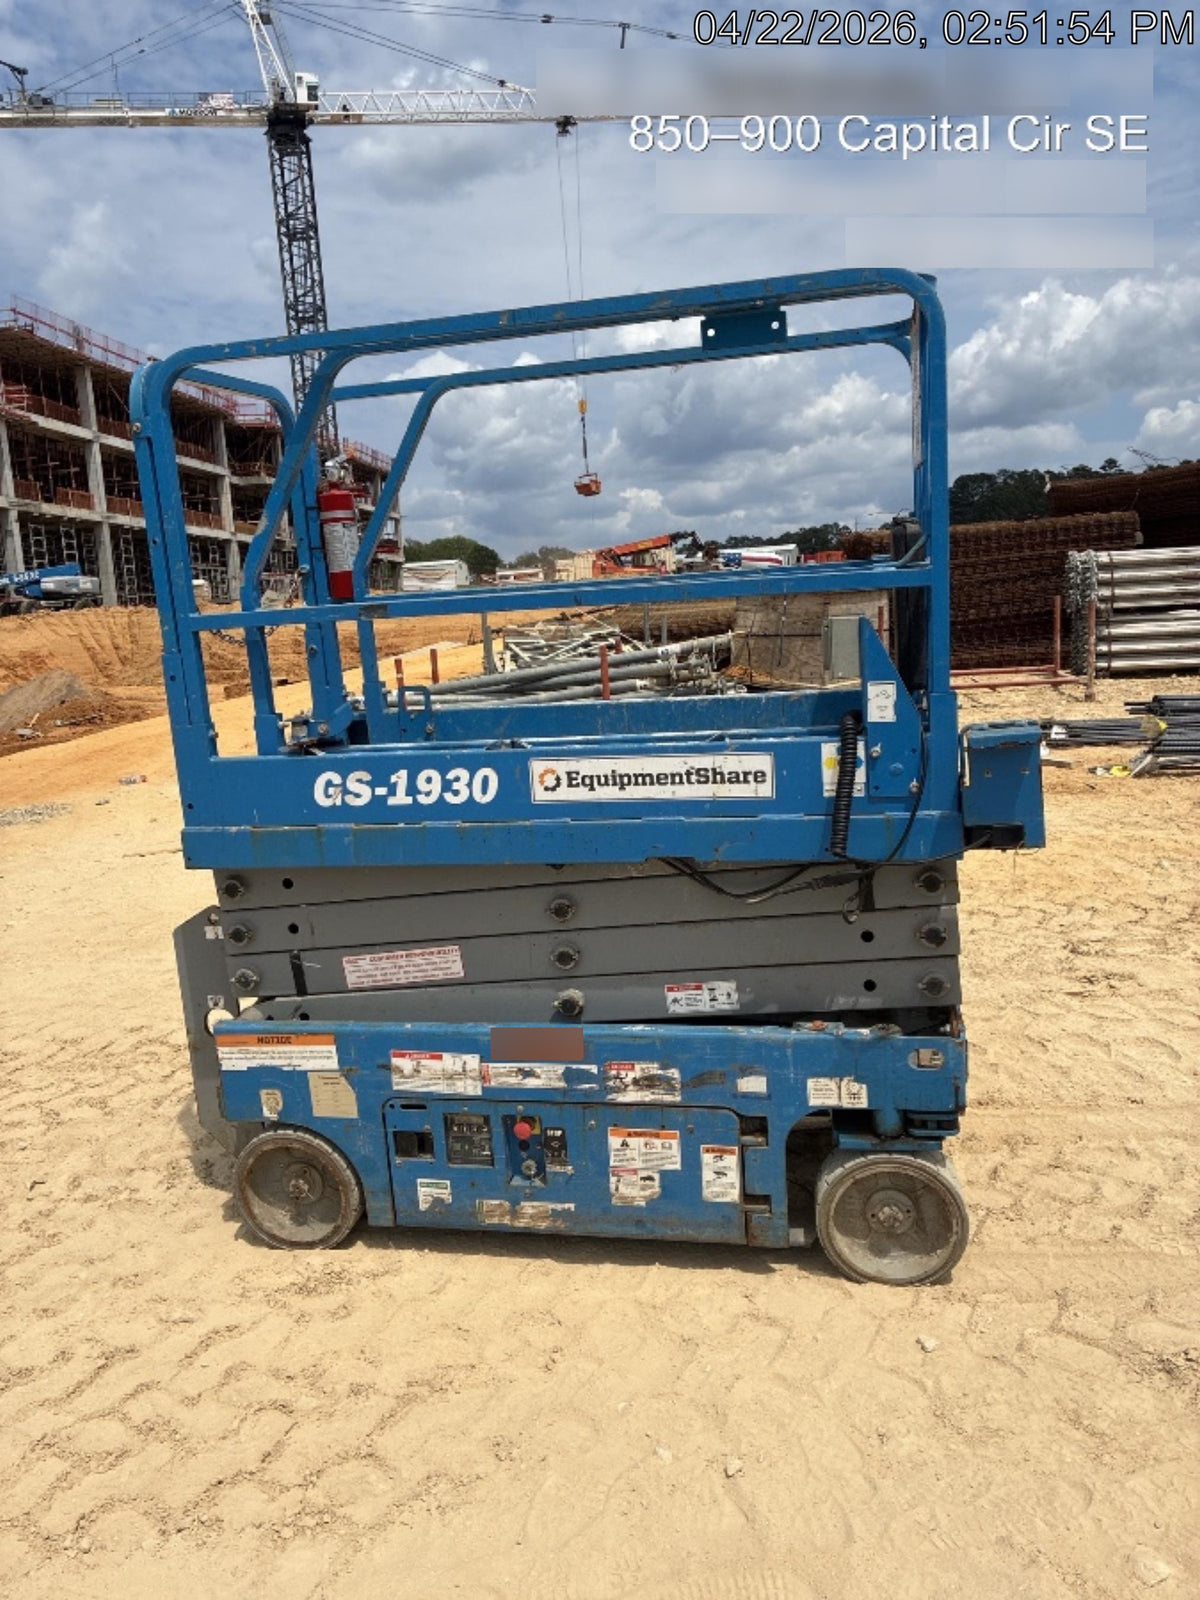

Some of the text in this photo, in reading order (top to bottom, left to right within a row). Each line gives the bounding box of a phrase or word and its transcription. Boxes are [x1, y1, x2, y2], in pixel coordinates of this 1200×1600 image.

[313, 767, 499, 808] GS-1930
[565, 765, 768, 791] EquipmentShare
[256, 1036, 293, 1045] NOTICE
